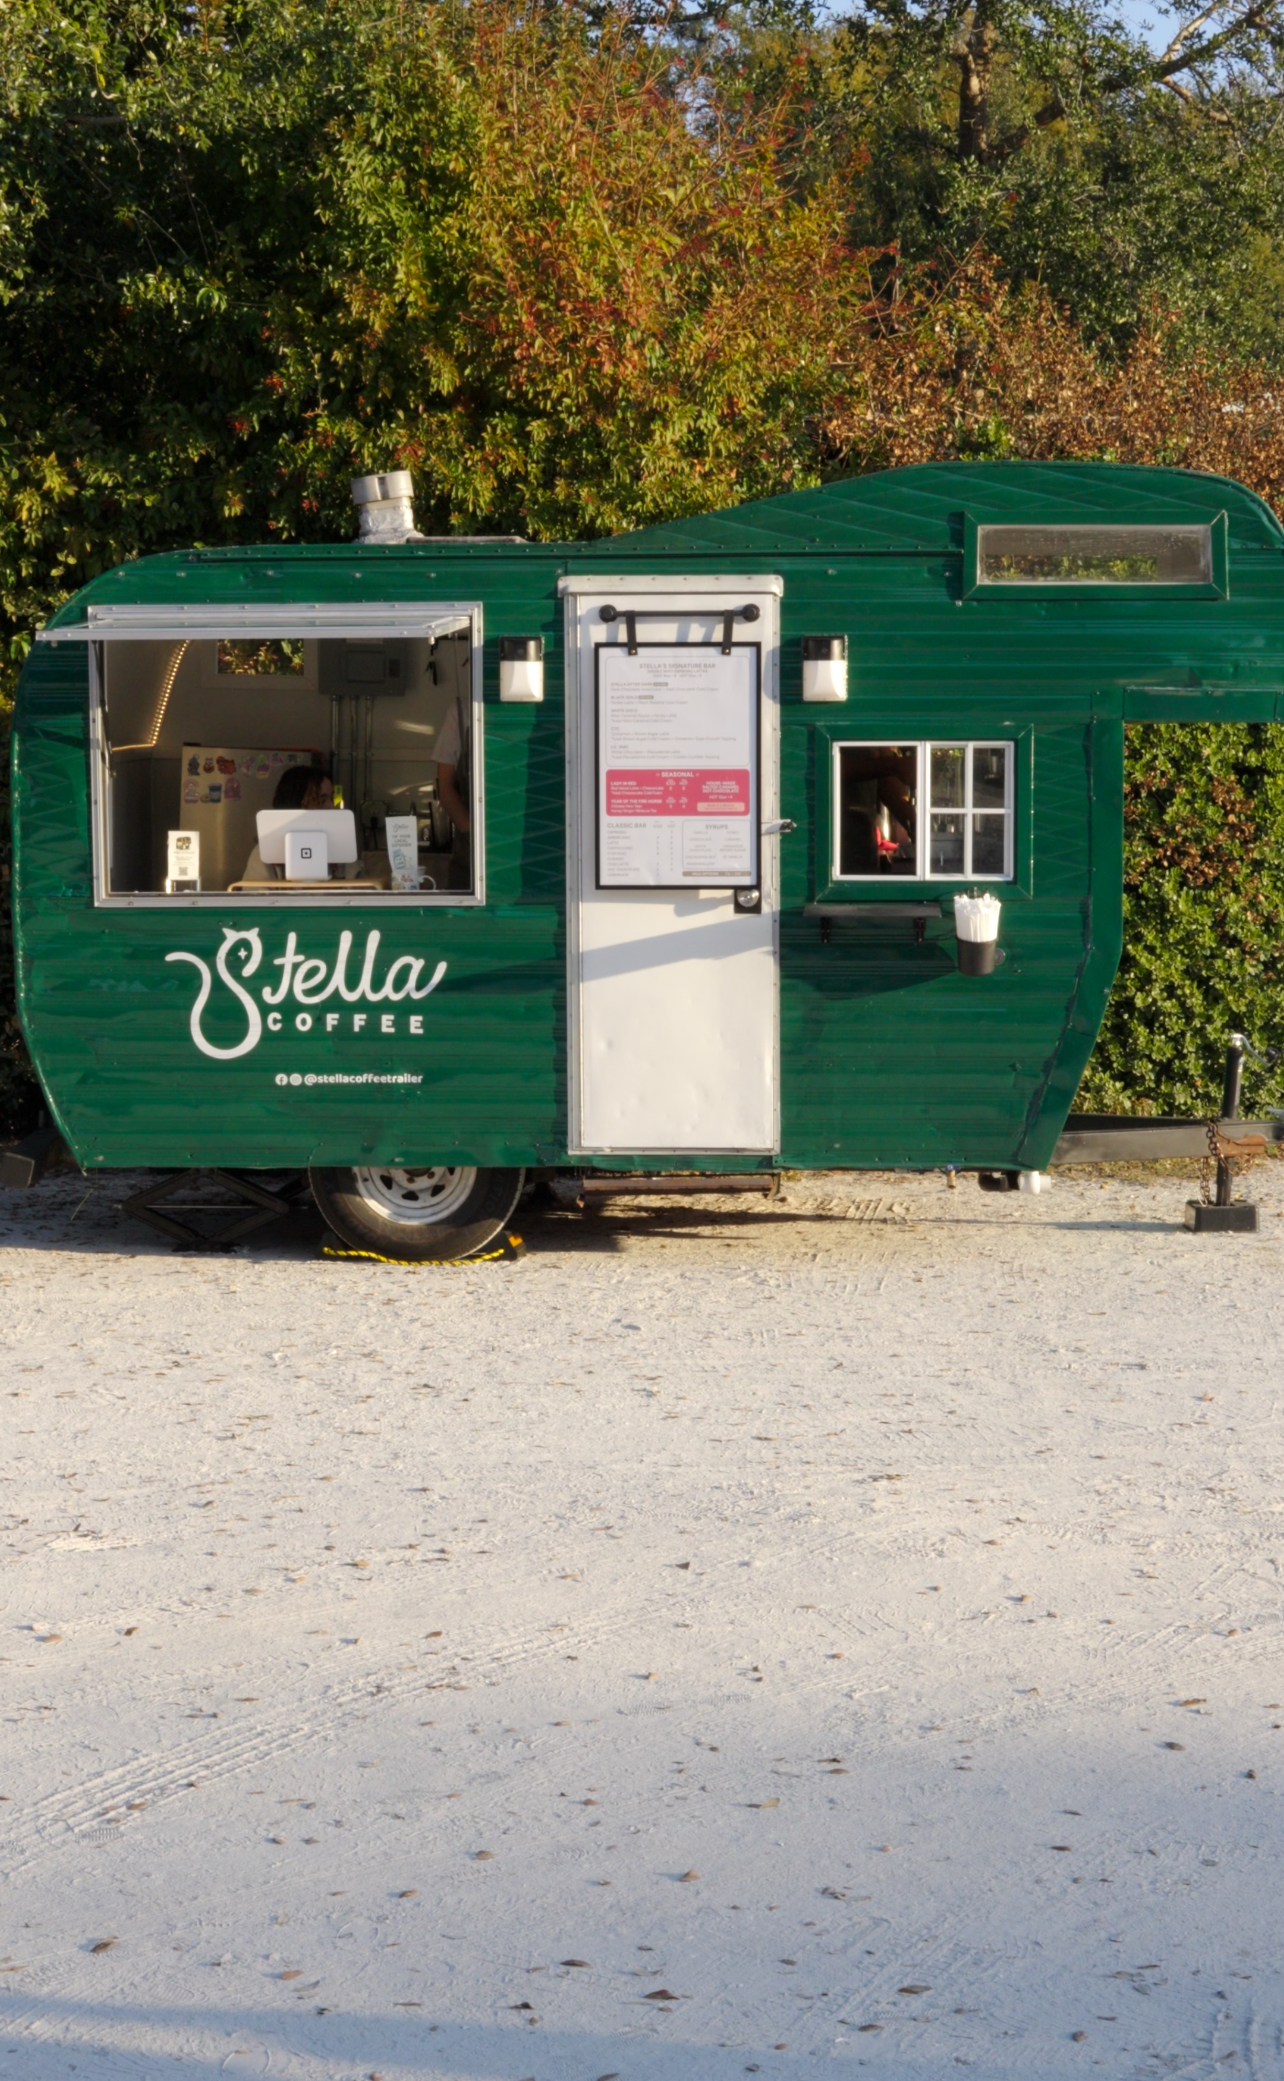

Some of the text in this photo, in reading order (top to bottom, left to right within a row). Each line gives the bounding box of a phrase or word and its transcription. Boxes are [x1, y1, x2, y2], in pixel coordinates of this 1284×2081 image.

[165, 927, 448, 1060] Stella
[267, 1012, 424, 1034] COFFEE
[304, 1073, 423, 1086] @stellacoffeetrailer
